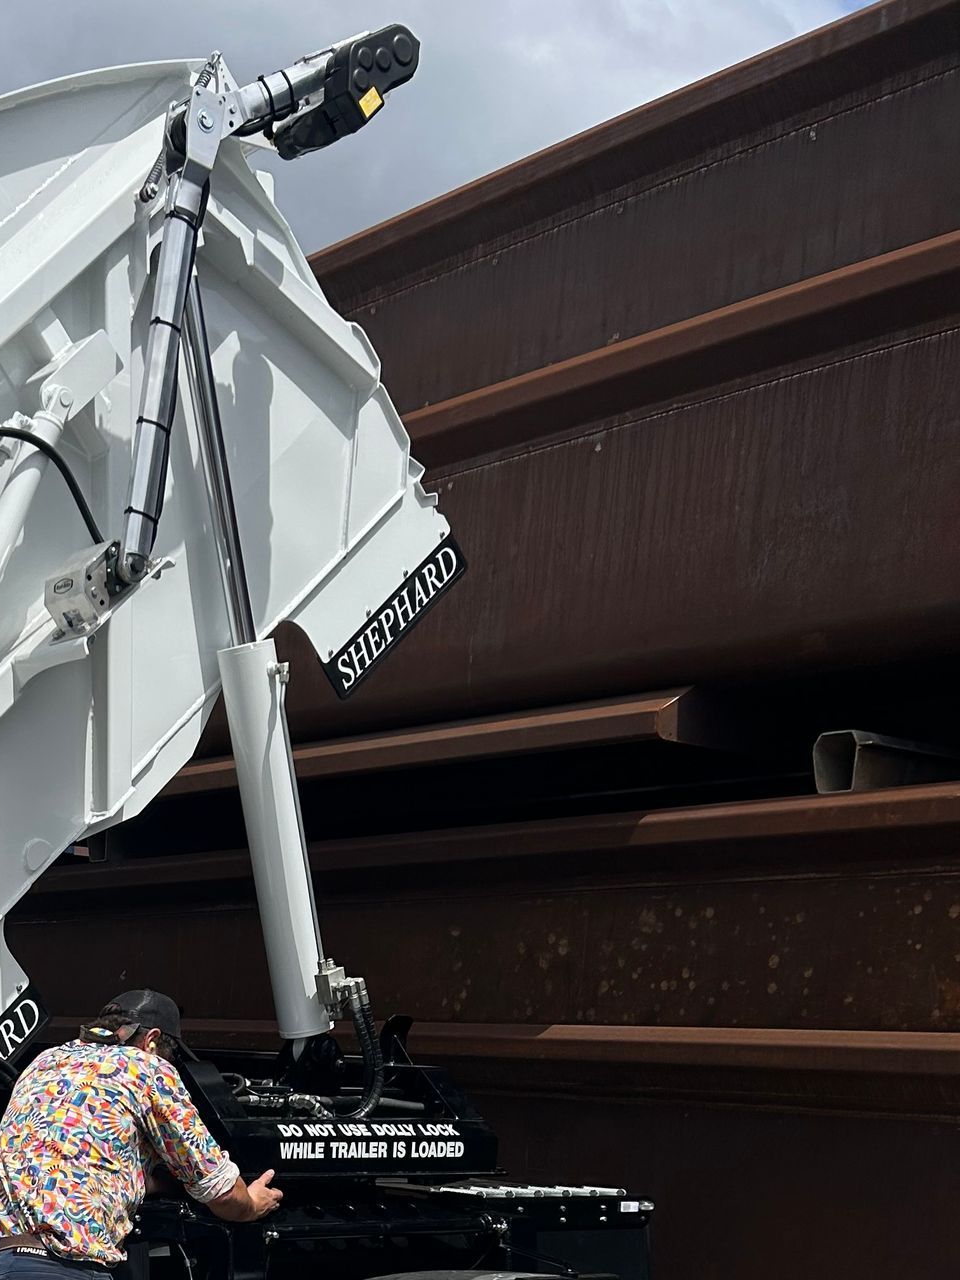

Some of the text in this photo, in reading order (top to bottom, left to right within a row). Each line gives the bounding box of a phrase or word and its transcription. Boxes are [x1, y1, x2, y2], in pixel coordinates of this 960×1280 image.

[337, 547, 457, 689] SHEPHARD
[277, 1124, 460, 1137] DO NOT USE DOLLY LOCK
[279, 1142, 464, 1160] WHILE TRAILER IS LOADED
